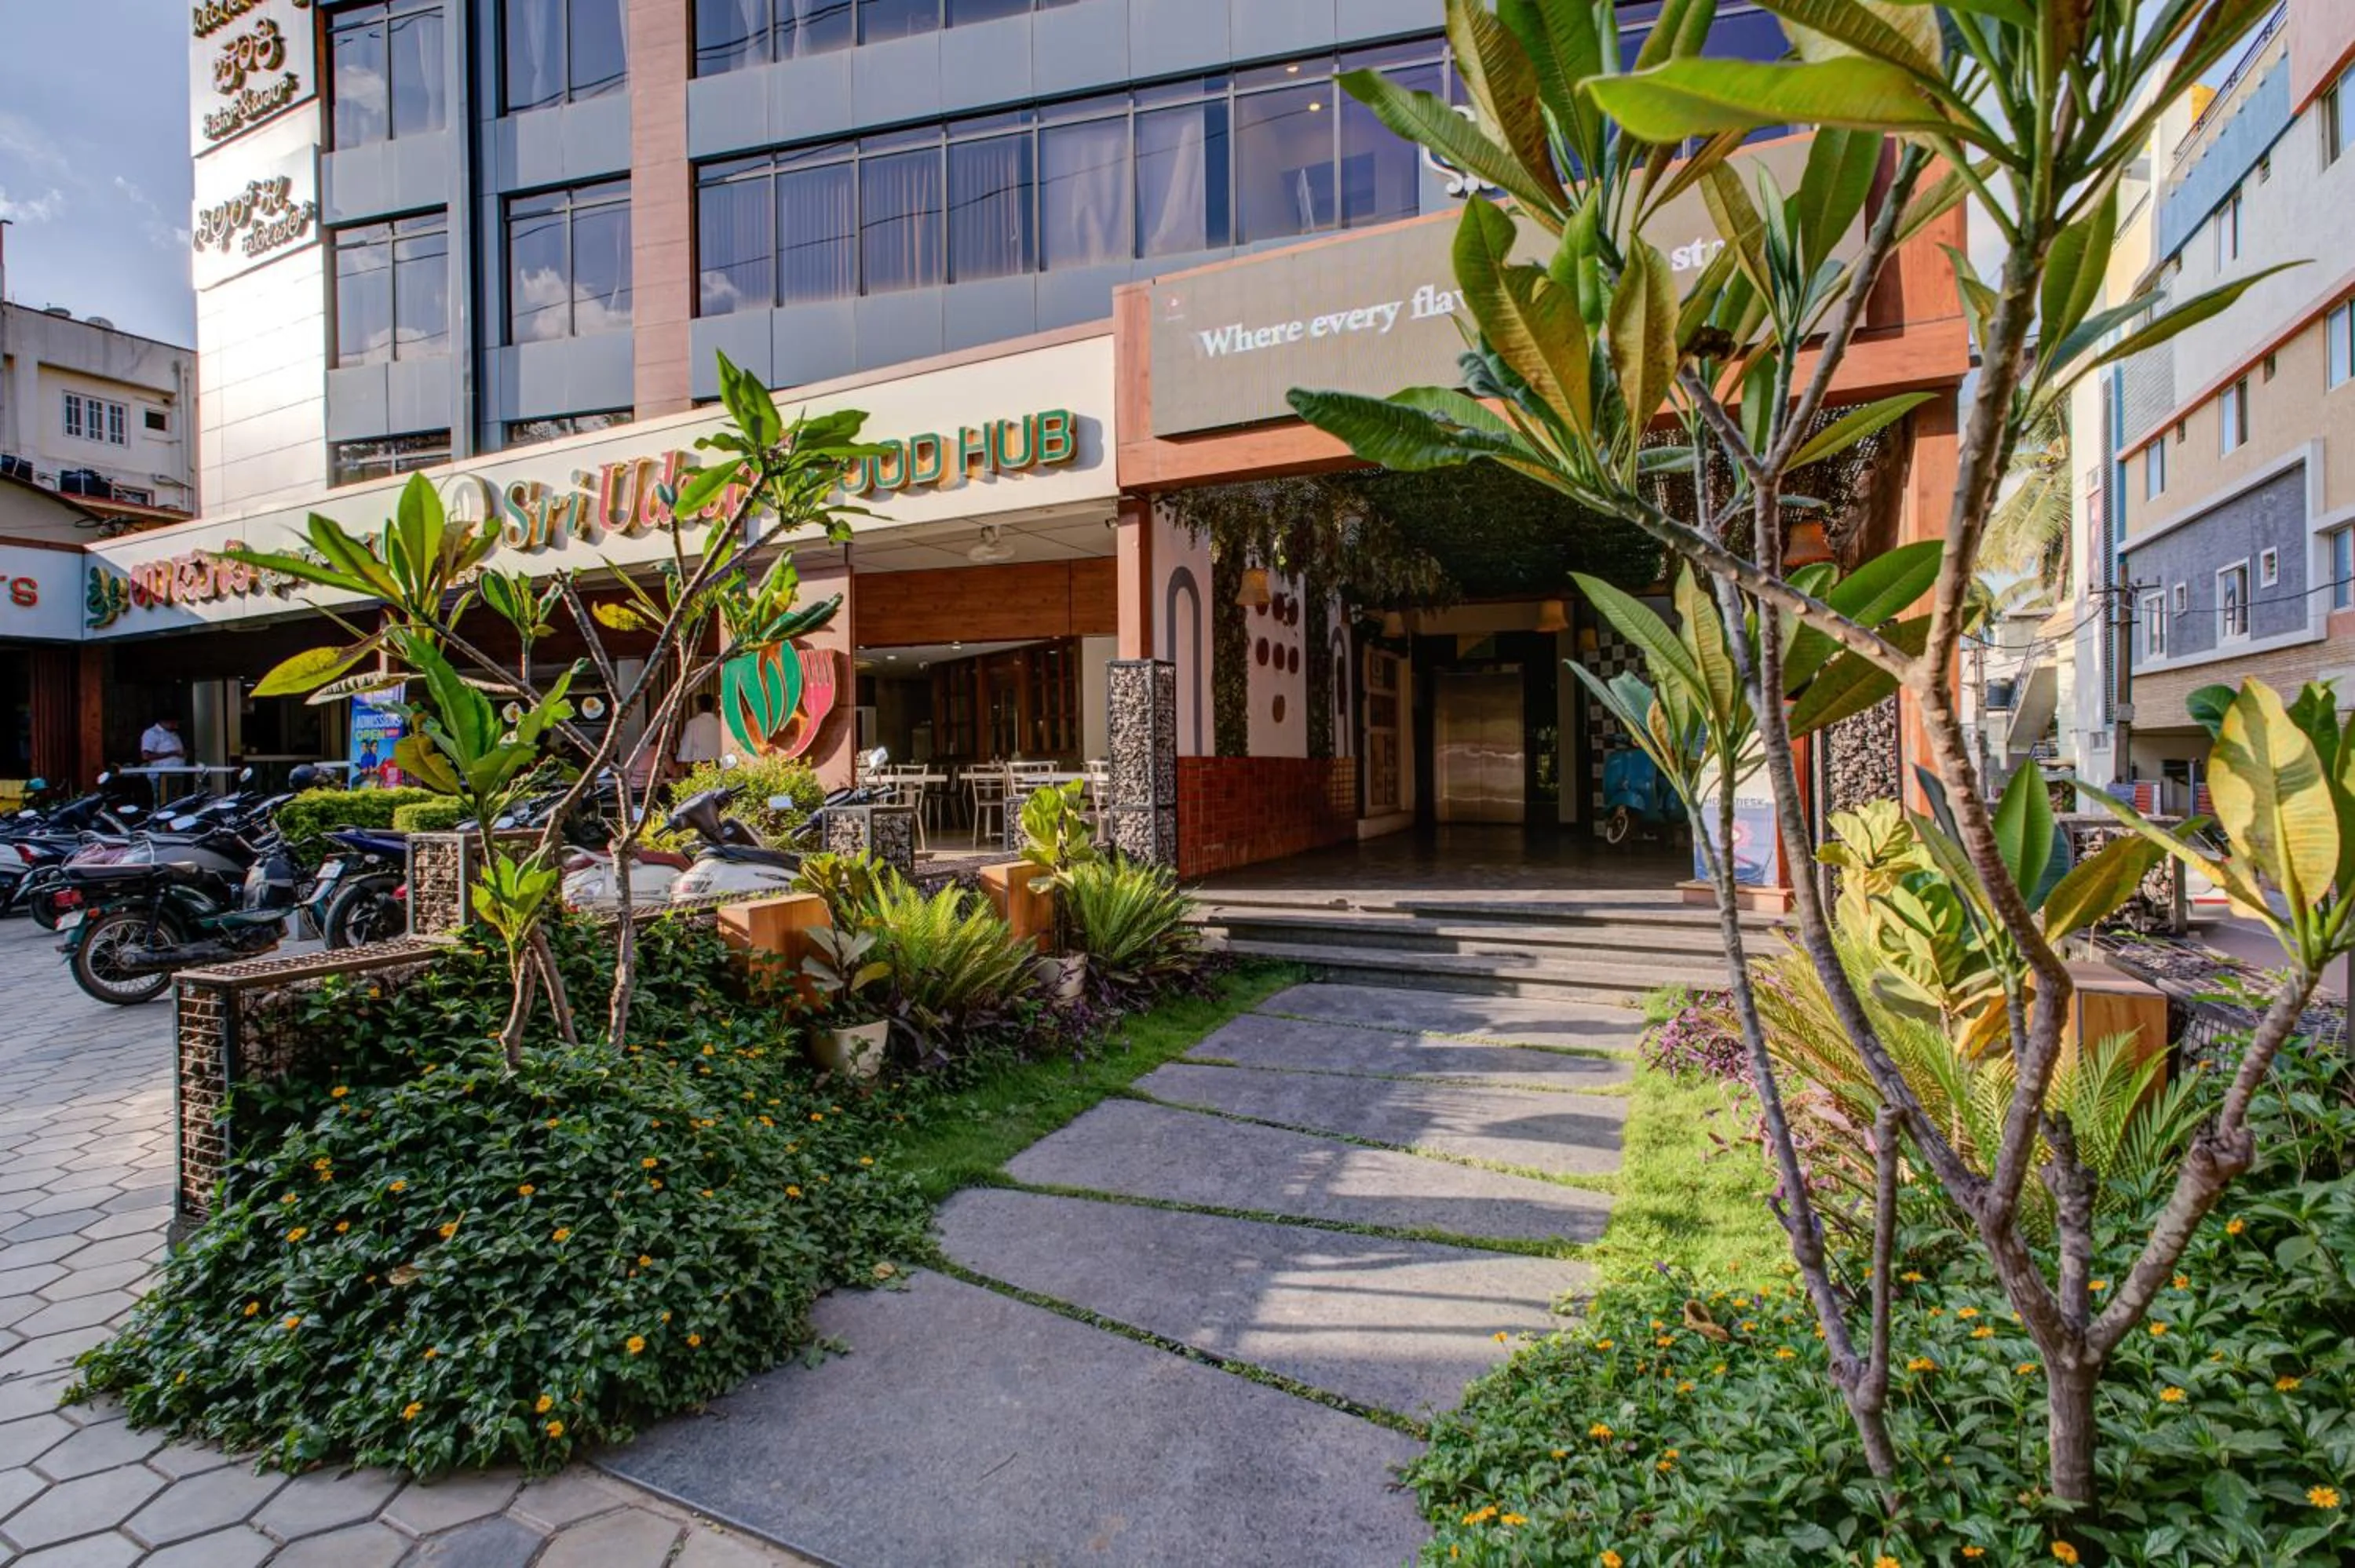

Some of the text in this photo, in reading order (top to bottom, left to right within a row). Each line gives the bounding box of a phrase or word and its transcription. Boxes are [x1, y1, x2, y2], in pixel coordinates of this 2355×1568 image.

[1199, 319, 1303, 358] Where
[1310, 301, 1404, 337] every
[502, 469, 590, 549] Sri
[837, 432, 944, 495] OOD
[958, 408, 1077, 474] HUB
[355, 728, 385, 741] OPEN
